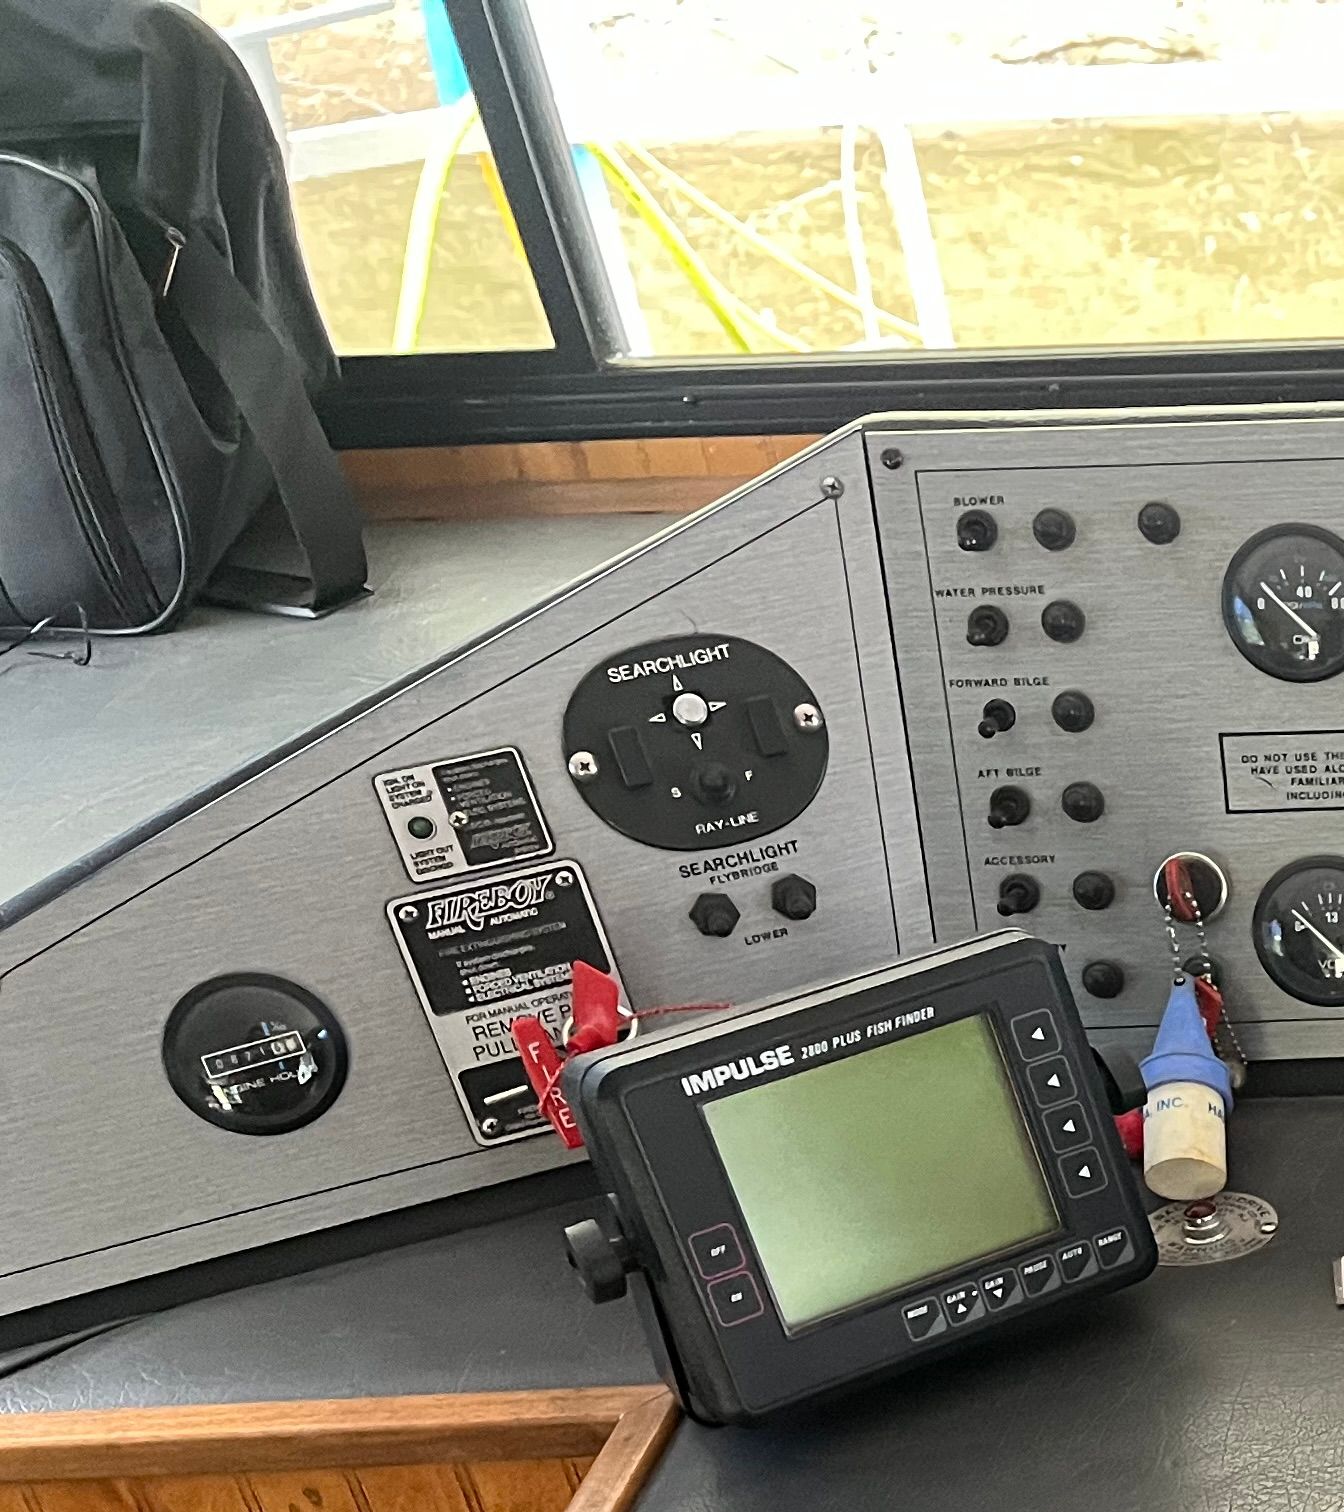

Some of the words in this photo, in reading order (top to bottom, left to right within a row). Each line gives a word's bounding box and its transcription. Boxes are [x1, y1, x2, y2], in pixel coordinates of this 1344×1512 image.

[954, 495, 1004, 506] BLOWER
[935, 588, 975, 598] WATER
[981, 585, 1045, 596] PRESSURE
[607, 643, 729, 684] SEARCHLIGHT
[949, 678, 1007, 688] FORWARD
[1014, 677, 1049, 686] BILGE
[1241, 755, 1258, 763] DO
[1264, 753, 1288, 762] NOT
[1295, 752, 1317, 761] USE
[978, 769, 998, 778] AFT
[1006, 767, 1041, 777] BILGE
[1251, 766, 1279, 775] HAVE
[1285, 765, 1317, 774] USED
[671, 787, 681, 798] S
[695, 811, 759, 835] RAY-LINE
[679, 840, 798, 878] SEARCHLIGHT
[984, 855, 1055, 865] ACCESSORY
[709, 862, 779, 886] FLYBRIDGE
[426, 874, 552, 931] FIREBOY
[1326, 912, 1338, 923] 13
[744, 928, 788, 945] LOWER
[488, 1002, 528, 1017] MANUAL
[473, 1008, 556, 1040] REME
[473, 1038, 518, 1061] PULL
[681, 1045, 794, 1096] IMPULSE
[832, 1030, 861, 1049] PLUS
[867, 1017, 892, 1037] FISH
[895, 1006, 934, 1028] FINDER
